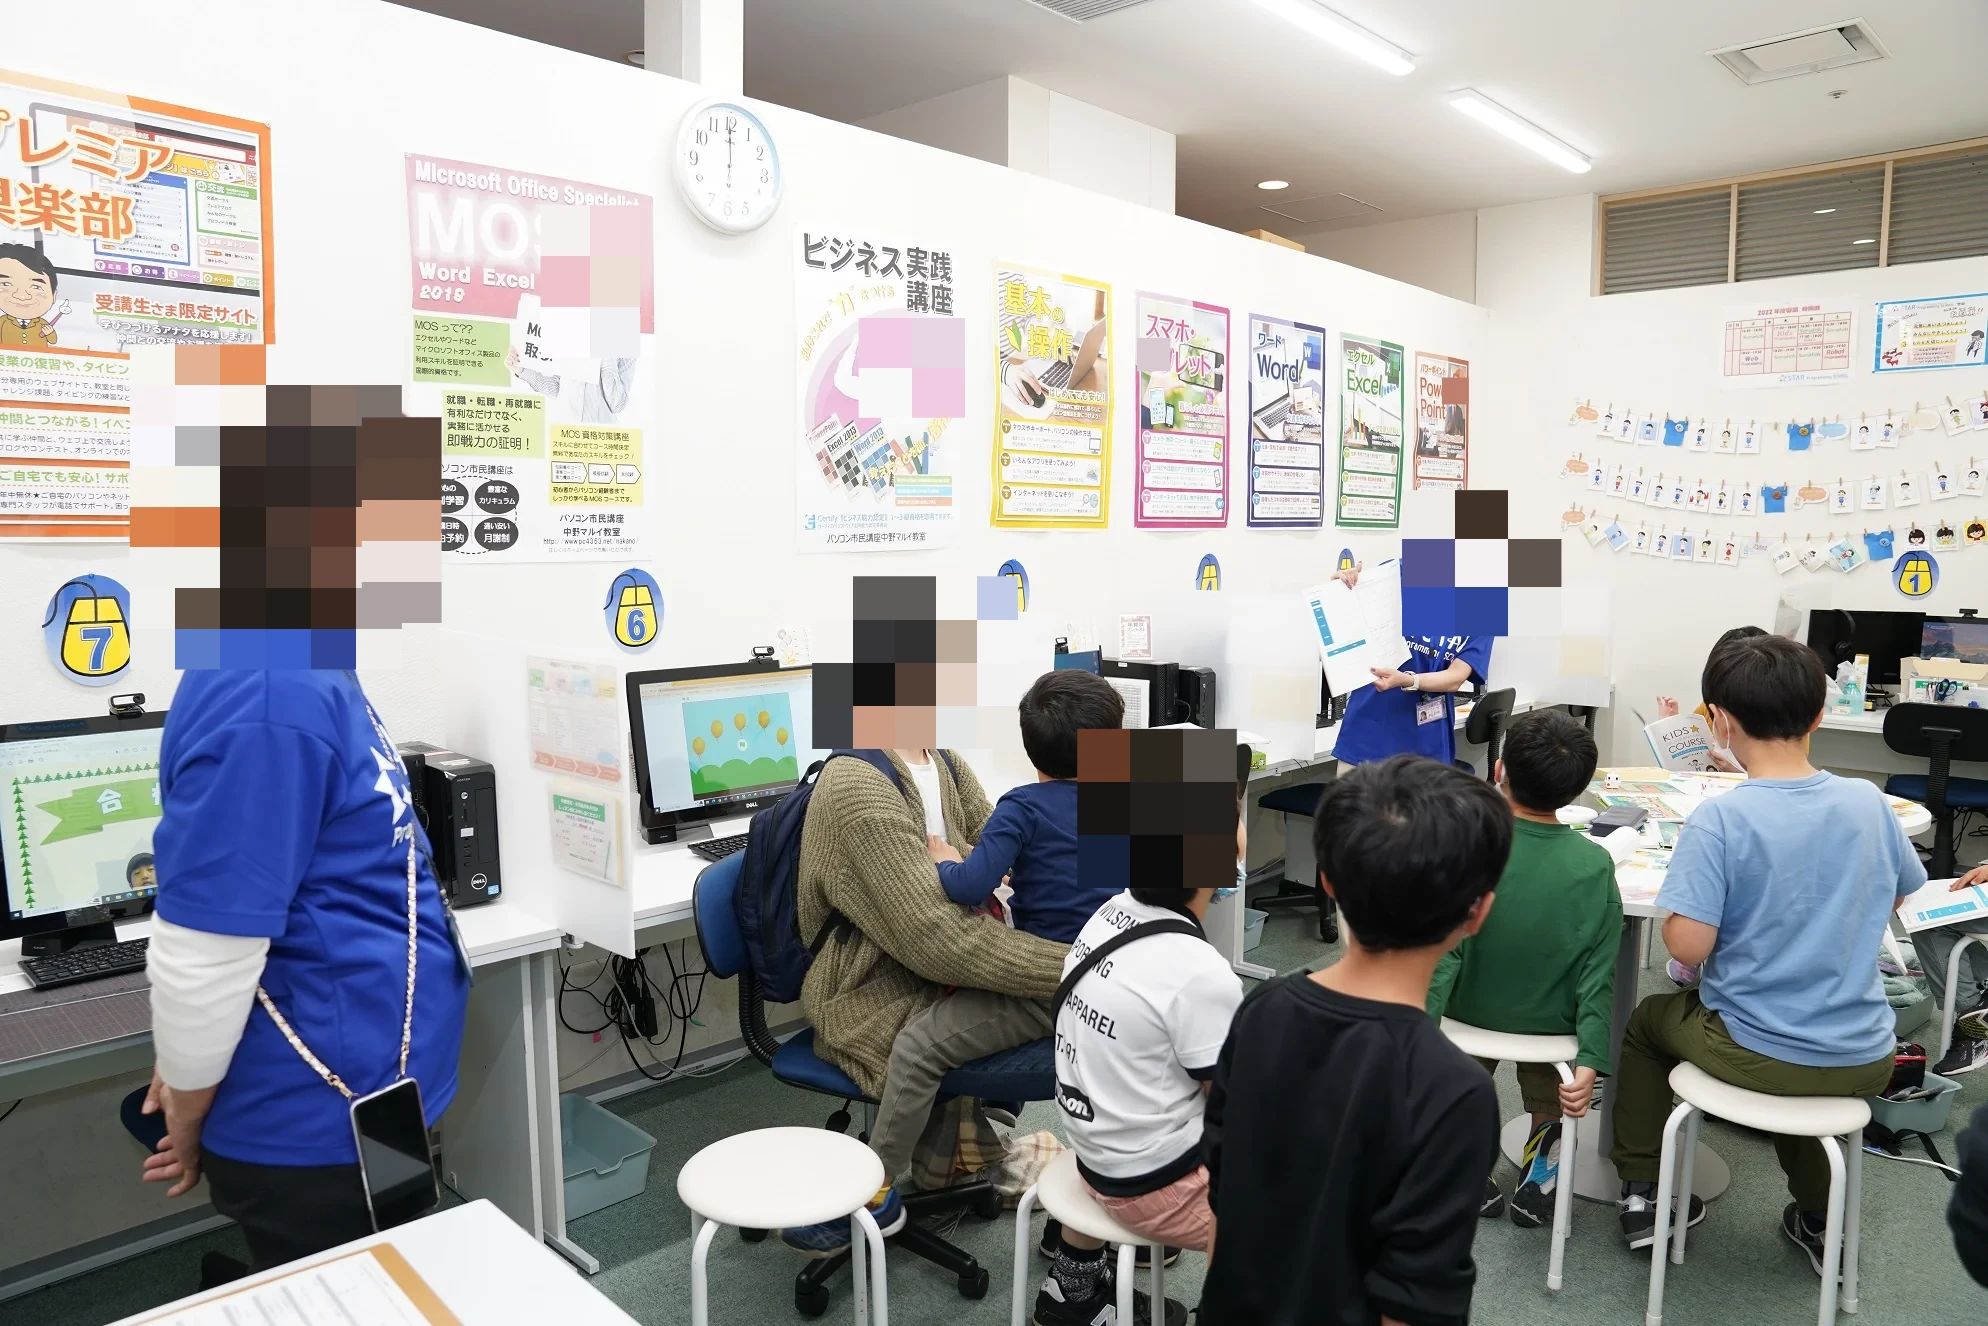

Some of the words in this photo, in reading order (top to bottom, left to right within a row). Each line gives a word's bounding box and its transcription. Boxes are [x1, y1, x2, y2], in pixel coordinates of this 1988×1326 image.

[709, 116, 719, 133] 11
[725, 116, 737, 132] 12
[696, 129, 708, 146] 10
[746, 127, 751, 142] 1
[689, 150, 699, 166] 9
[756, 145, 764, 161] 2
[415, 160, 502, 193] Microsoft
[507, 175, 559, 202] Office
[760, 168, 769, 184] 3
[416, 192, 541, 262] MO
[418, 261, 471, 284] Word
[483, 267, 536, 290] Excel
[419, 284, 465, 303] 2019
[906, 280, 954, 316] 講座
[95, 293, 256, 325] 受講生さま限定サイト
[1003, 280, 1065, 324] 基本の
[415, 319, 439, 332] MOS
[526, 322, 541, 337] M
[415, 334, 477, 346] エクセルやワードなど
[1027, 324, 1073, 361] 操作
[1258, 332, 1282, 348] ワード
[415, 345, 501, 358] マイクロソフトオフィス製品の
[1303, 346, 1312, 358] W
[1347, 350, 1376, 366] エクセル
[1169, 347, 1212, 377] レット
[1256, 352, 1299, 383] Word
[1386, 362, 1391, 374] X
[0, 377, 129, 392] 分専用のウェブサイトで、教室と同じ
[1347, 368, 1383, 396] Excel
[1420, 377, 1443, 398] Pow
[446, 395, 542, 410] 就職・転職・再就職に
[1420, 398, 1446, 419] Point
[446, 408, 522, 422] 有利なだけでなく、
[446, 421, 511, 434] 実務に活かせる
[560, 429, 581, 439] MOS
[581, 430, 630, 441] 資格対策講座
[446, 433, 531, 451] 即戦力の証明！
[826, 436, 845, 453] Excel
[842, 425, 858, 442] 2013
[853, 437, 871, 453] Word
[442, 464, 514, 475] ソコン市民講座は
[441, 484, 457, 492] 心の
[441, 495, 465, 506] 学習
[479, 497, 516, 505] カリキュラム
[559, 513, 625, 524] パソコン市民講座
[563, 527, 621, 537] 中野マルイ教室
[827, 532, 926, 543] パソコン市民講座中野マルイ教室
[1909, 574, 1919, 593] 1
[626, 607, 647, 642] 6
[80, 626, 114, 671] 7
[1662, 726, 1690, 743] KIDS
[1668, 737, 1707, 754] COURSE
[1066, 991, 1117, 1040] APPAREL
